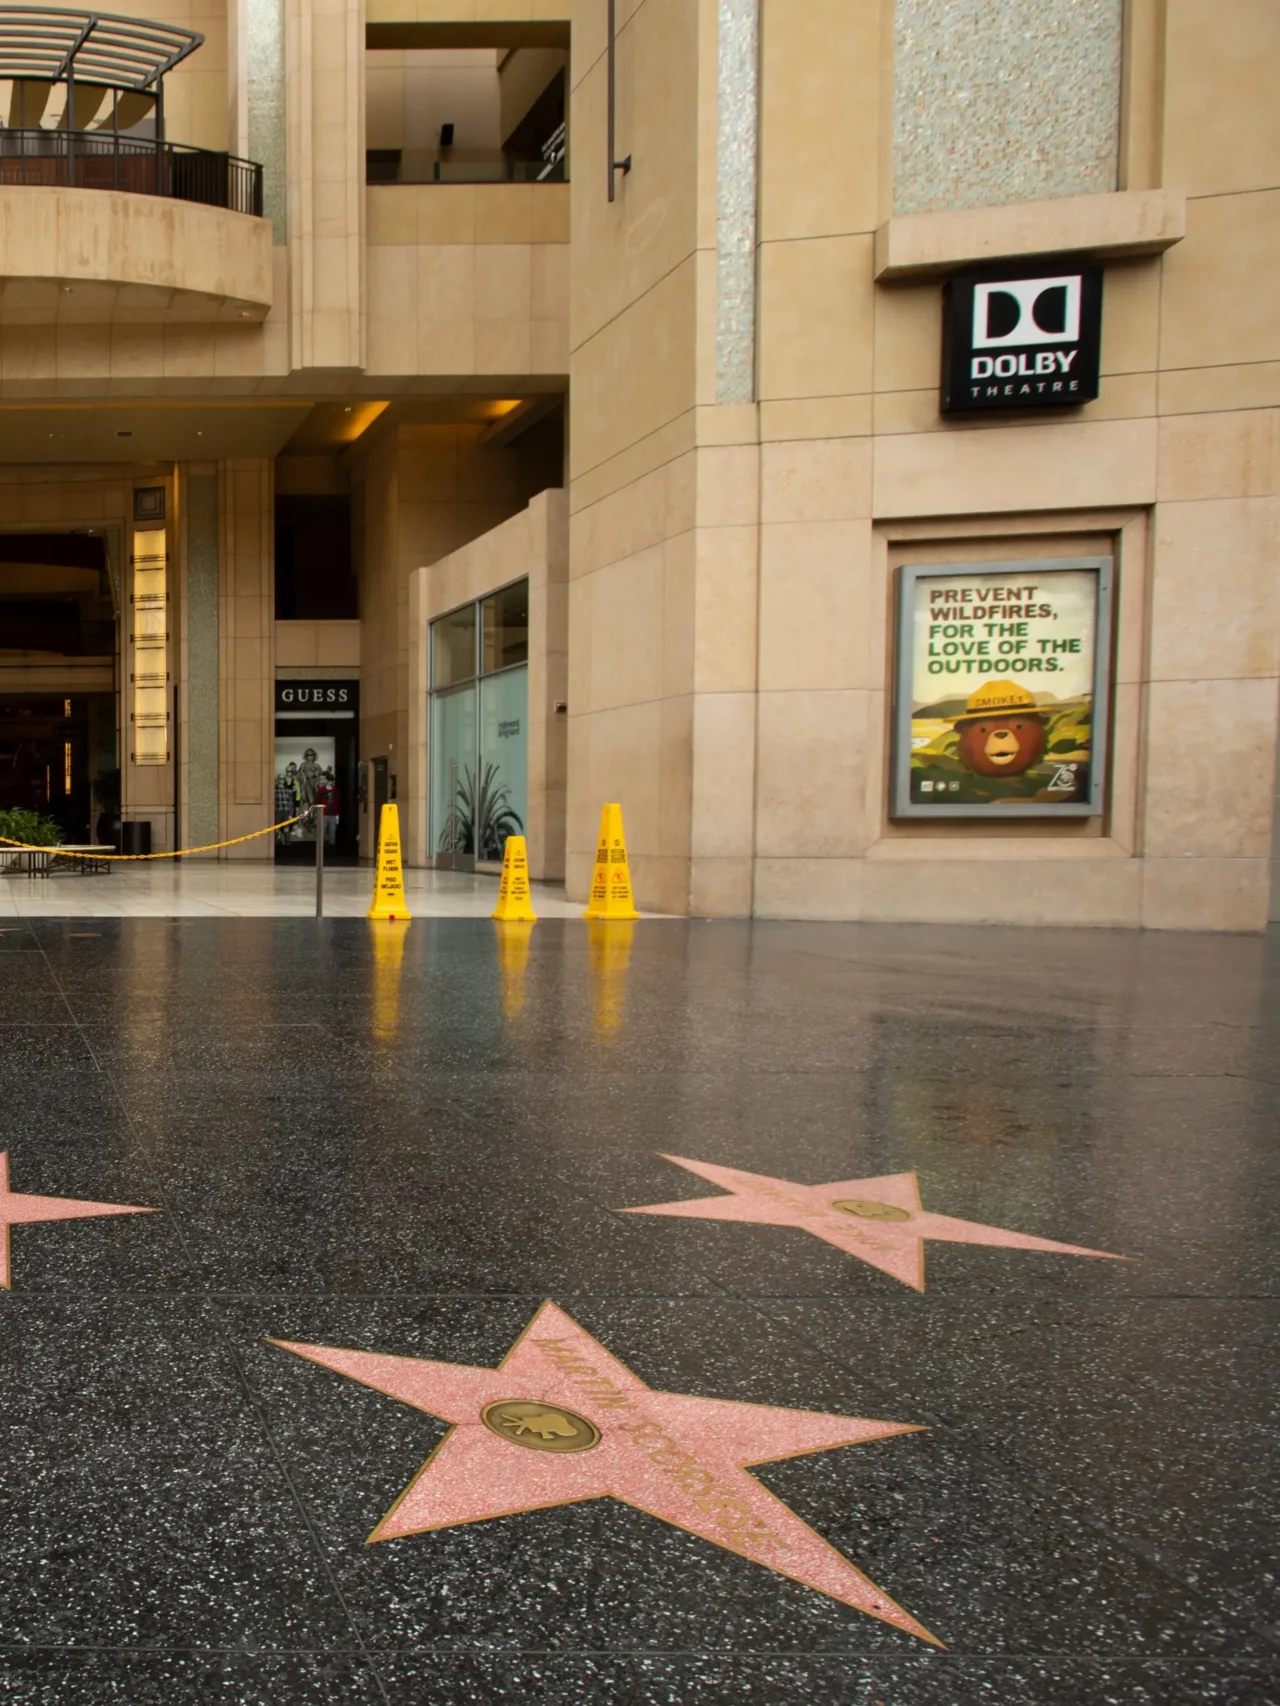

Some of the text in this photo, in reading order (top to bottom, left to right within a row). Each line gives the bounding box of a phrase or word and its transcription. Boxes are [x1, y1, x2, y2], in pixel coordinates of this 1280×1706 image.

[970, 349, 1079, 379] DOLBY
[970, 380, 1080, 398] THEATRE
[929, 586, 1038, 604] PREVENT
[929, 603, 1059, 622] WILDFIRES,
[928, 622, 1029, 640] FOR THE
[927, 638, 1082, 657] LOVE OF THE
[927, 657, 1065, 675] OUTDOORS.
[281, 688, 349, 703] GUESS
[974, 694, 1024, 708] SMOKEY
[529, 1338, 787, 1548] MARTIN SCORSESE
